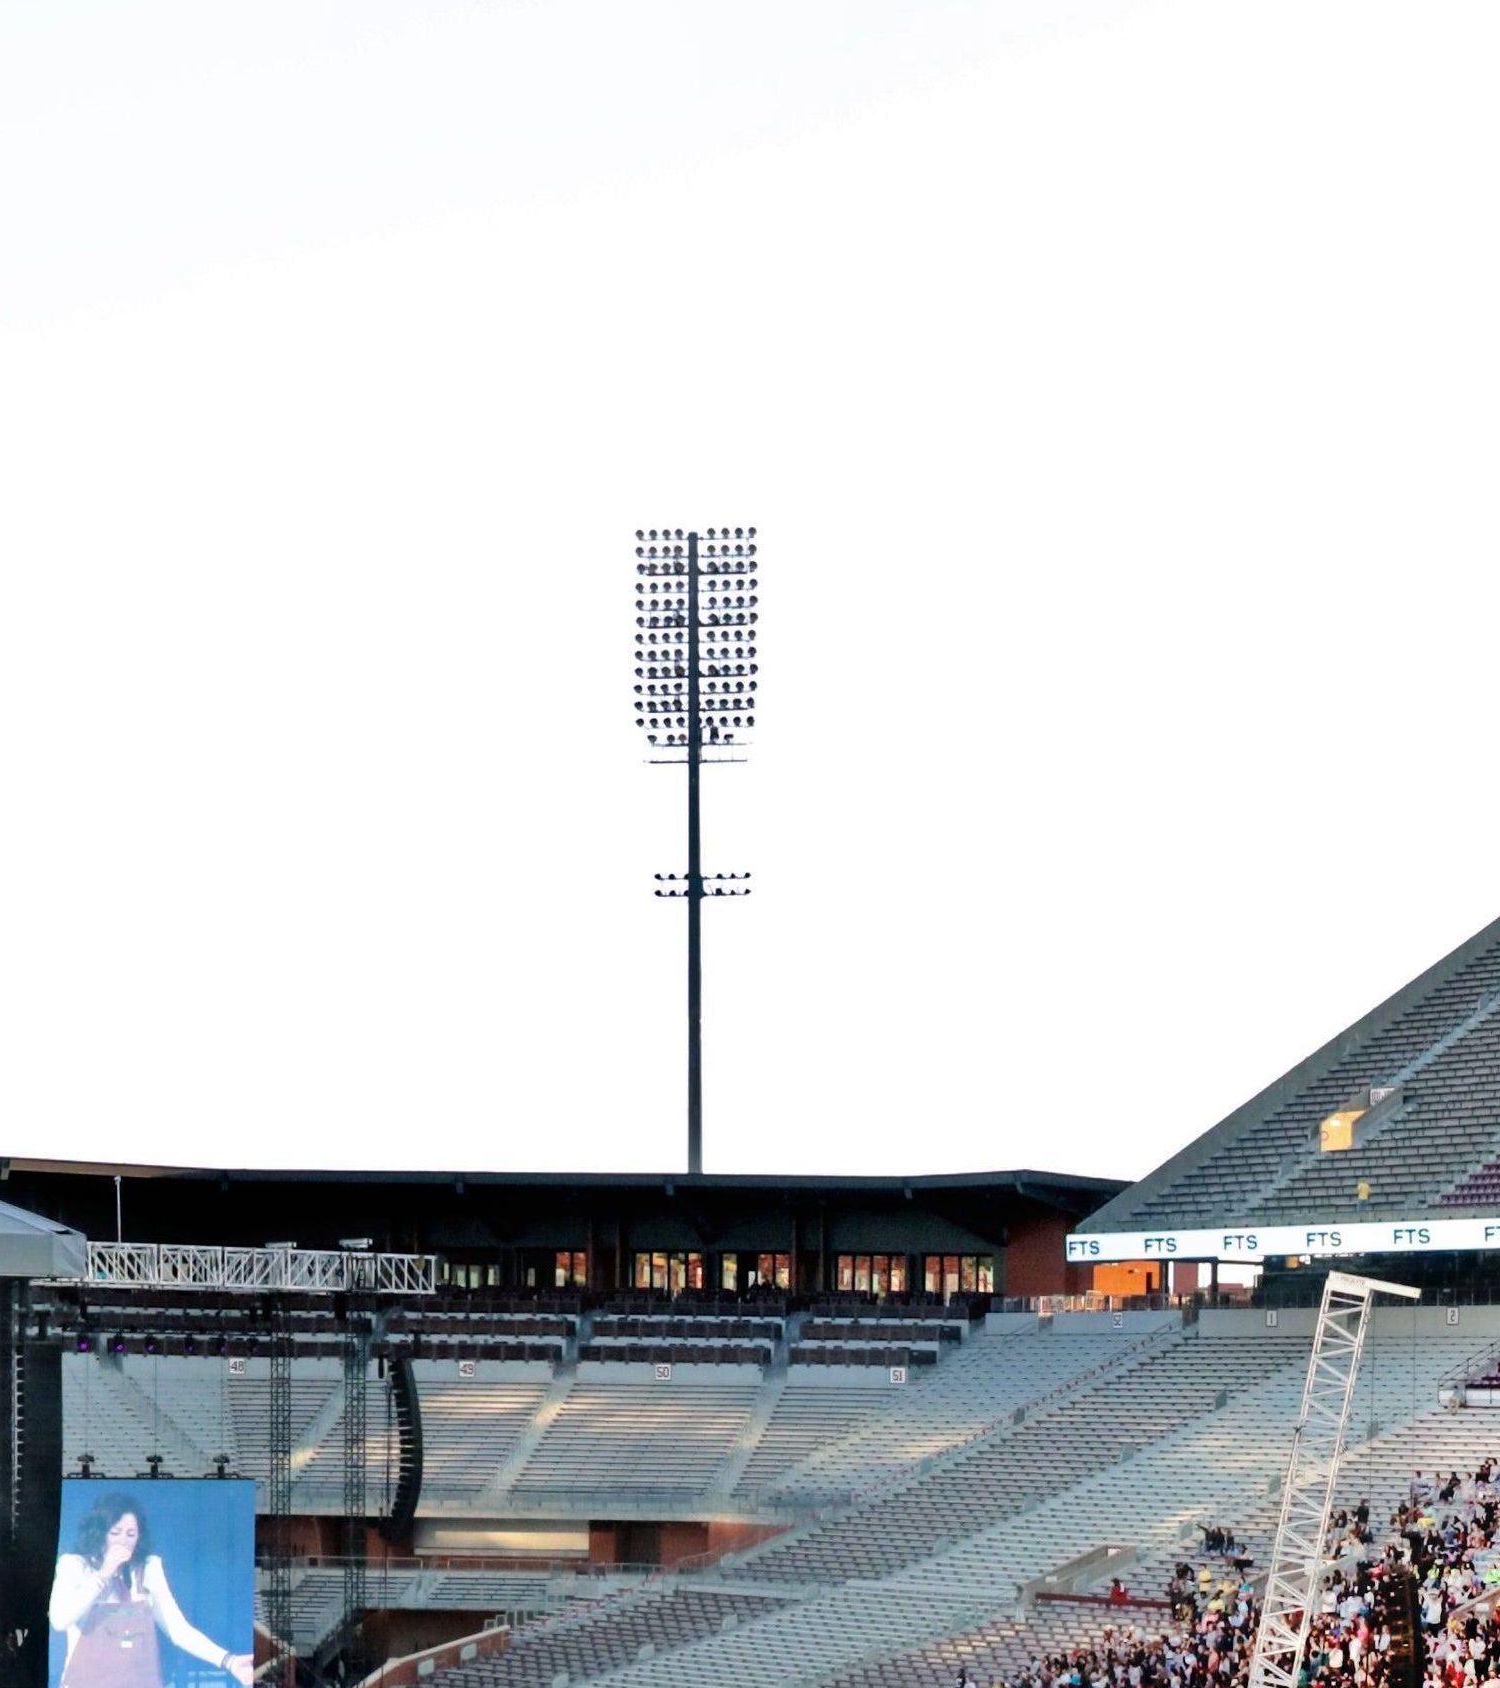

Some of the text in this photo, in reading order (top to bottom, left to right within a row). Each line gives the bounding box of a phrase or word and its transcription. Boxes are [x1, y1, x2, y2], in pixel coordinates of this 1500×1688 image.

[1223, 1235, 1257, 1250] FTS
[1307, 1232, 1341, 1247] FTS
[1394, 1229, 1430, 1244] FTS
[1069, 1241, 1100, 1256] FTS
[1144, 1238, 1177, 1252] FTS
[231, 1360, 245, 1372] 48
[656, 1366, 670, 1378] 50
[892, 1370, 903, 1382] 51
